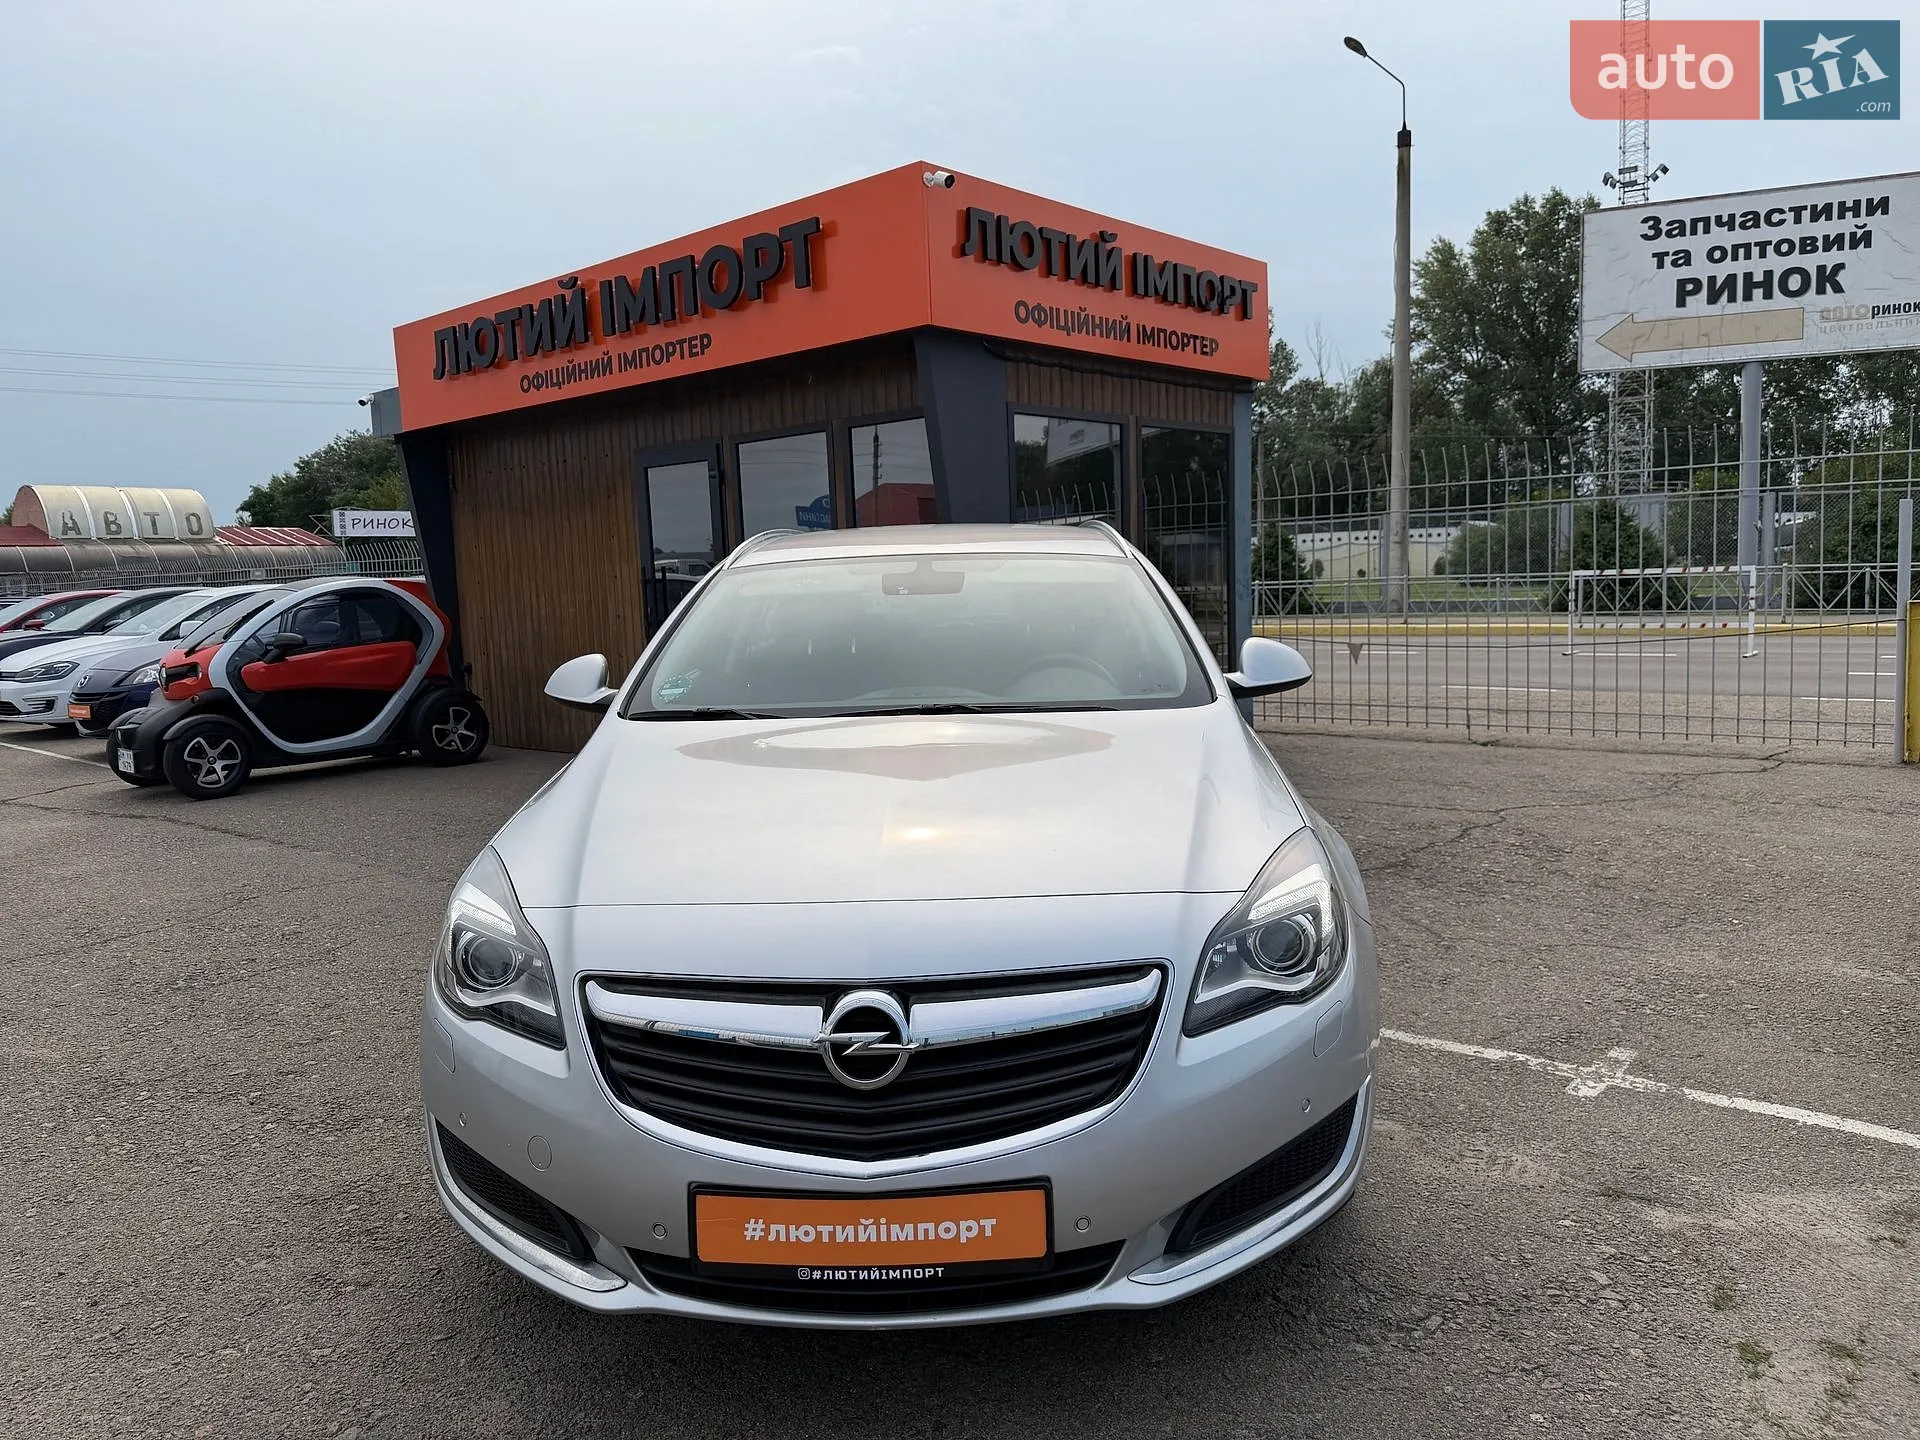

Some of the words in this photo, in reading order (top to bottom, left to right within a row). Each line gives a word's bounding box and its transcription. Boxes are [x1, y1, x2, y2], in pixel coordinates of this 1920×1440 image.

[1639, 195, 1890, 242] Запчастини
[964, 206, 1124, 291] ЛЮТИЙ
[1134, 252, 1258, 320] ІМПОРТ
[1652, 248, 1692, 270] та
[1706, 222, 1873, 264] оптовий
[433, 276, 590, 380] ЛЮТИЙ
[600, 217, 823, 338] ІМПОРТ
[1675, 262, 1846, 309] РИНОК
[1014, 300, 1131, 343] ОФІЦІЙНИЙ
[1136, 323, 1219, 357] ІМПОРТЕР
[519, 350, 614, 394] ОФІЦІЙНИЙ
[618, 332, 713, 374] ІМПОРТЕР
[61, 510, 204, 536] АВТО
[351, 517, 415, 530] РИНОК
[743, 1217, 997, 1244] #лютийімпорт
